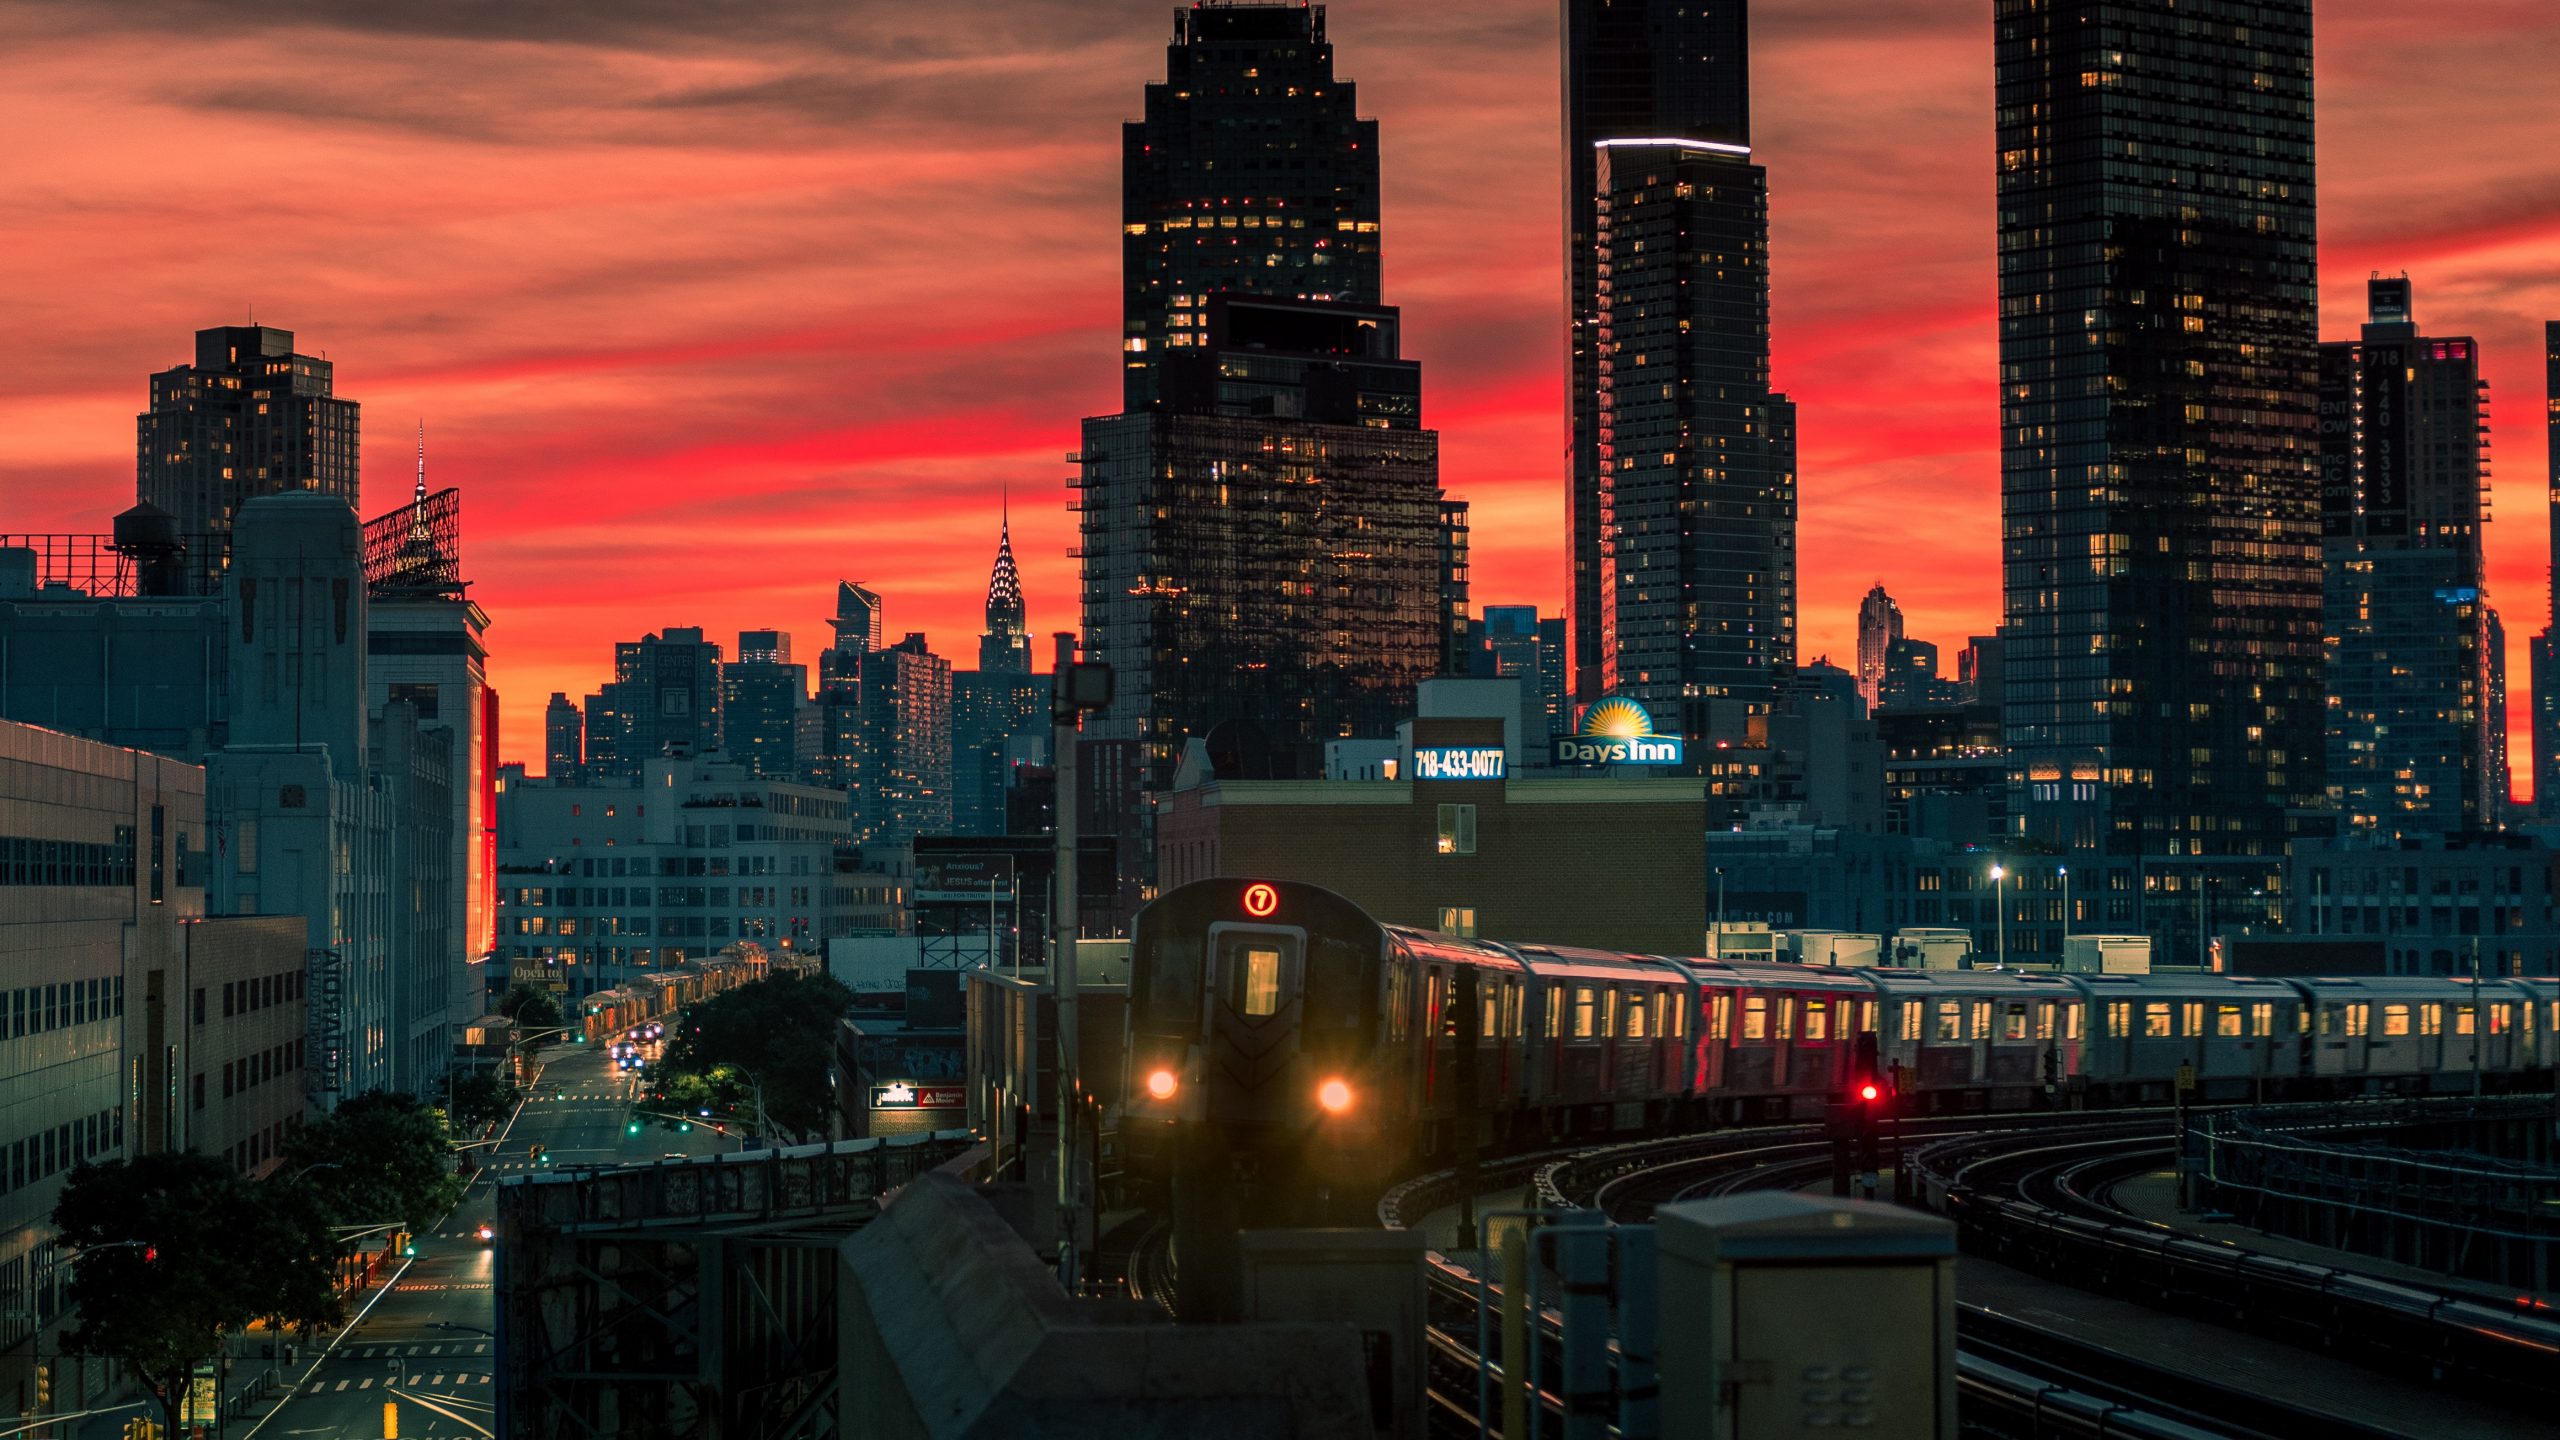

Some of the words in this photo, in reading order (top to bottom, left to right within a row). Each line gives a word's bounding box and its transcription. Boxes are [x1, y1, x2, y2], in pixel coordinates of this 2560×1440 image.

[2369, 352, 2399, 367] 718
[2321, 402, 2347, 415] ENT
[2320, 421, 2349, 434] OW
[2321, 468, 2344, 482] IC
[1559, 741, 1626, 763] Days
[1629, 740, 1676, 761] Inn
[1415, 750, 1504, 777] 718-433-0077
[945, 861, 984, 871] Anxious?
[944, 877, 973, 887] JESUS
[514, 966, 545, 981] Open
